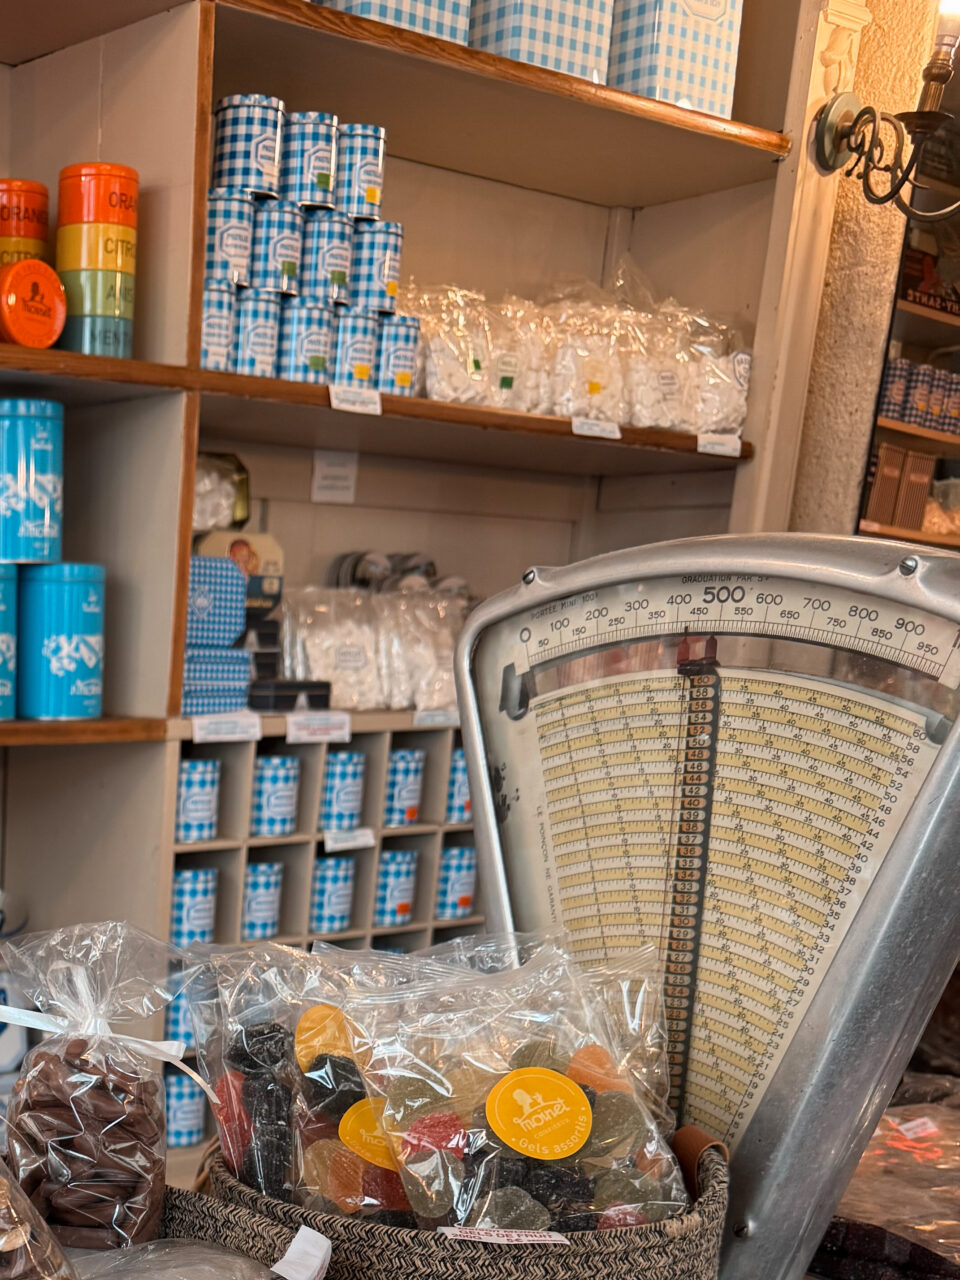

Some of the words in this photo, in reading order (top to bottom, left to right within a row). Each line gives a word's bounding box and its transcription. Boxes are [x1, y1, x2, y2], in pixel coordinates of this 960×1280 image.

[667, 594, 692, 605] 400
[703, 586, 746, 604] 500
[756, 593, 783, 606] 600
[624, 599, 649, 612] 300
[803, 597, 831, 611] 700
[585, 607, 609, 621] 200
[648, 610, 665, 620] 350
[690, 606, 709, 615] 450
[734, 607, 753, 616] 550
[780, 609, 800, 620] 650
[848, 605, 879, 622] 800
[550, 618, 570, 632] 100
[608, 617, 625, 627] 250
[826, 617, 846, 628] 750
[894, 617, 925, 636] 900
[520, 628, 531, 643] 0
[572, 627, 587, 636] 150
[871, 627, 892, 640] 850
[538, 639, 550, 647] 50
[916, 641, 939, 655] 950
[696, 689, 708, 697] 58
[912, 729, 927, 741] 60
[905, 742, 920, 754] 58
[900, 754, 914, 766] 56
[894, 767, 909, 778] 54
[889, 780, 903, 792] 52
[687, 799, 700, 807] 40
[883, 792, 897, 803] 50
[878, 804, 892, 815] 48
[872, 815, 886, 827] 46
[866, 827, 880, 839] 44
[860, 839, 874, 851] 42
[854, 852, 868, 863] 40
[848, 863, 862, 874] 39
[843, 875, 856, 885] 38
[838, 885, 852, 896] 37
[833, 897, 847, 909] 36
[827, 909, 841, 920] 35
[822, 920, 836, 931] 34
[817, 932, 830, 943] 33
[812, 943, 825, 954] 32
[808, 955, 819, 965] 31
[801, 964, 814, 975] 30
[796, 976, 809, 987] 29
[792, 986, 804, 997] 28
[786, 997, 800, 1007] 27
[782, 1008, 794, 1019] 26
[777, 1018, 789, 1029] 25
[772, 1029, 784, 1040] 24
[767, 1039, 779, 1050] 23
[762, 1049, 774, 1060] 22
[758, 1060, 769, 1070] 21
[753, 1070, 765, 1081] 20
[512, 1097, 571, 1133] moinet
[518, 1137, 549, 1155] Gels
[554, 1112, 588, 1153] assortis
